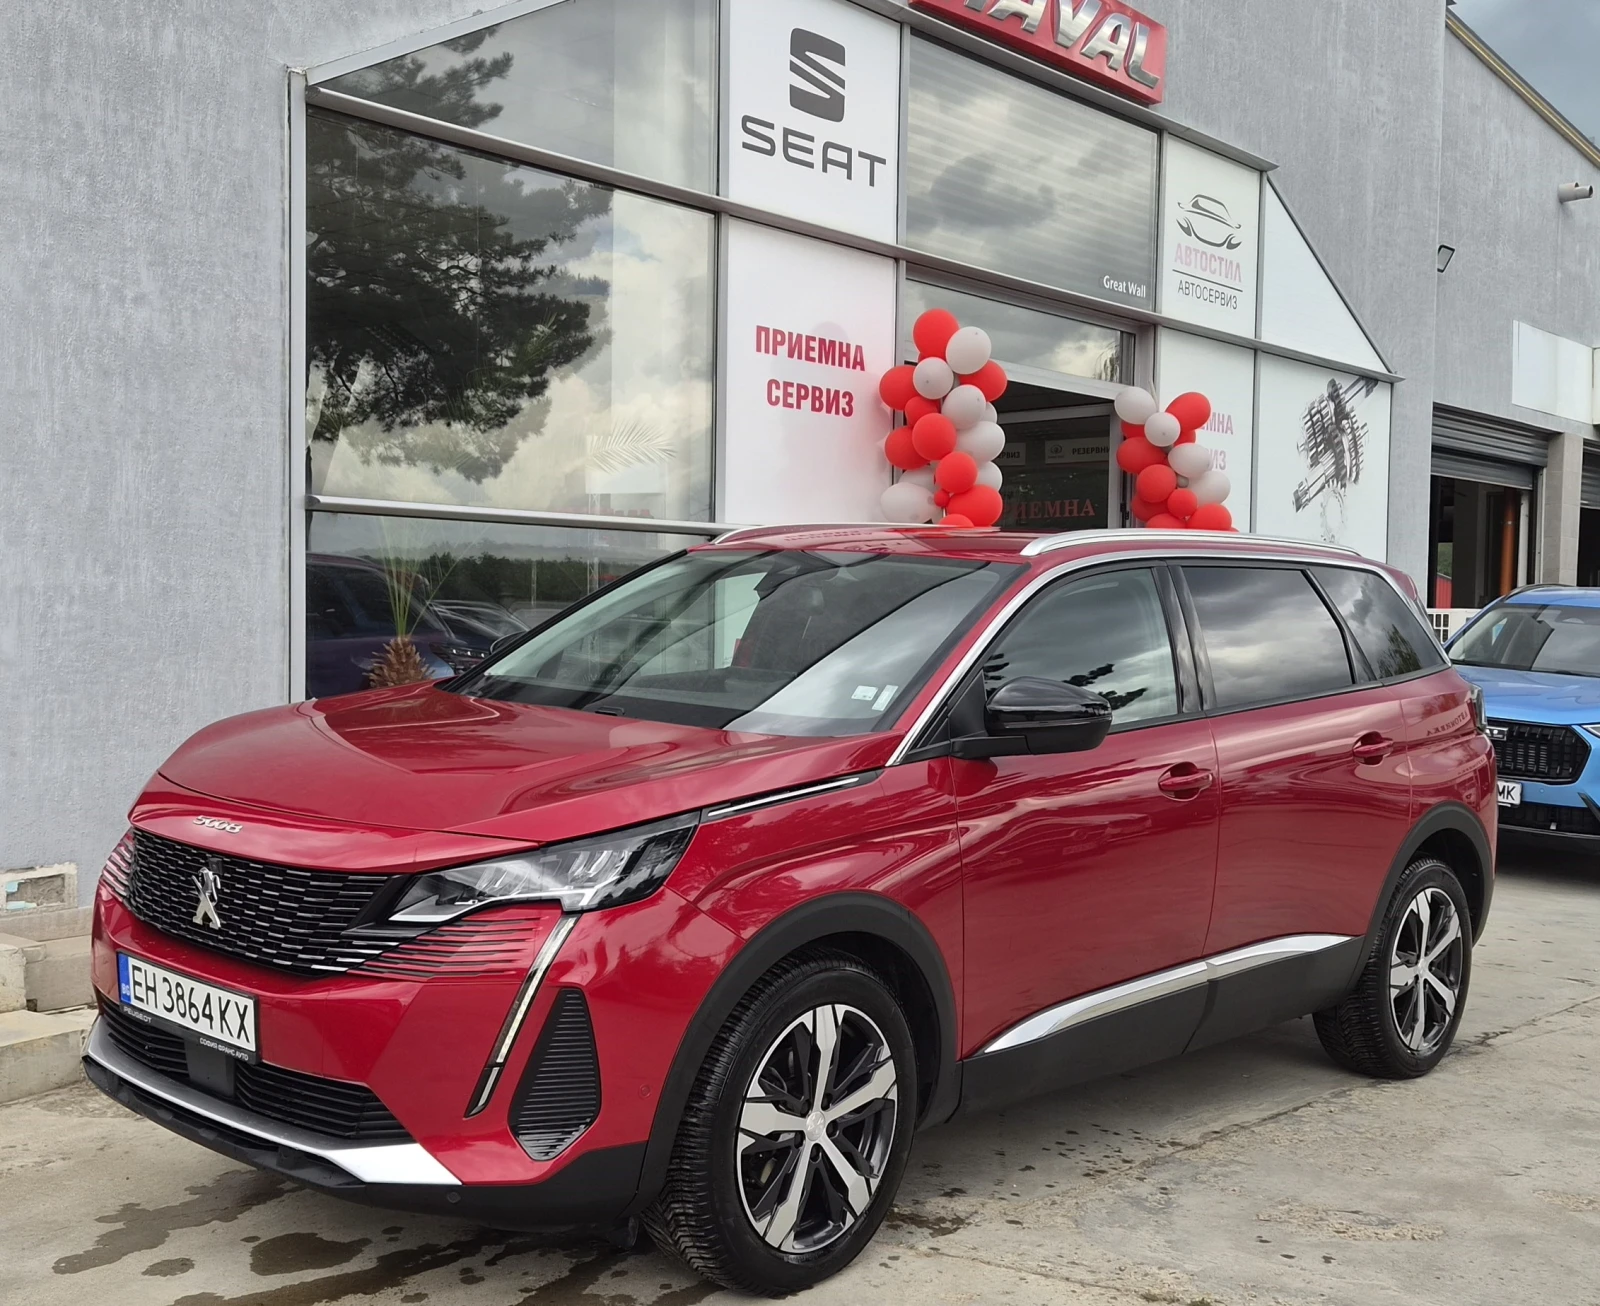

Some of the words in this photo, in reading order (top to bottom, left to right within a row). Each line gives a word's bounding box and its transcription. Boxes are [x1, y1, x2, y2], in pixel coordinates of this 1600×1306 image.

[963, 0, 1160, 89] AVAL
[741, 114, 887, 188] SEAT
[1174, 242, 1242, 283] АВТОСТИЛ
[1103, 275, 1127, 294] Great
[1127, 281, 1146, 298] Wall
[1177, 279, 1238, 310] АВТОСЕРВИЗ
[755, 324, 866, 372] ПРИЕМНА
[766, 378, 854, 418] СЕРВИЗ
[1003, 498, 1096, 520] РИЕМНА
[193, 815, 243, 834] 5008
[123, 1006, 152, 1024] PEUGEOT
